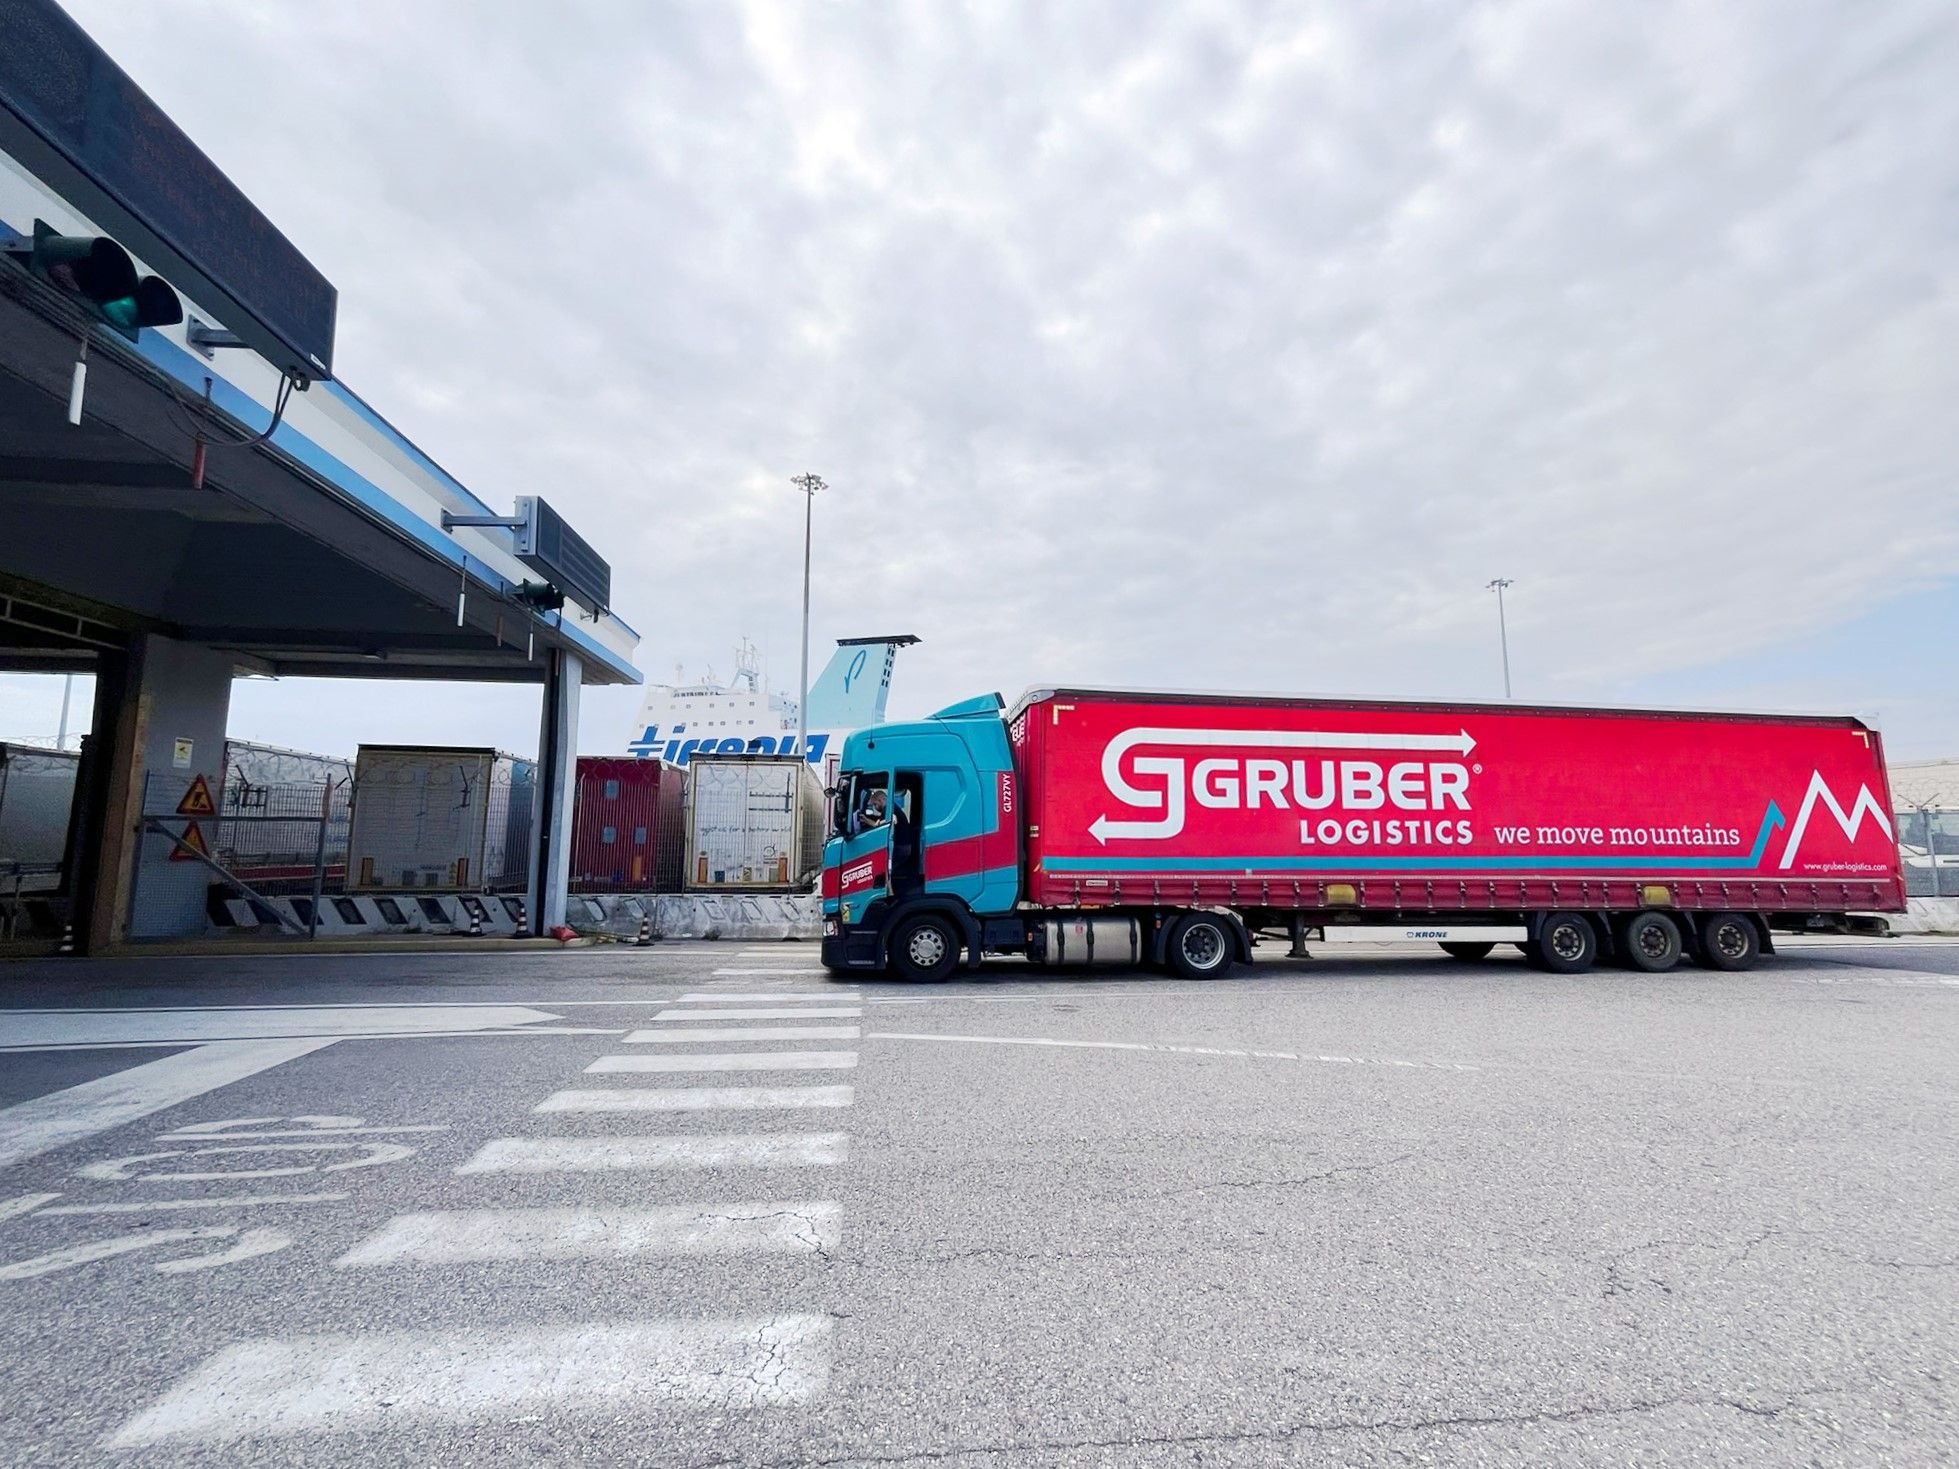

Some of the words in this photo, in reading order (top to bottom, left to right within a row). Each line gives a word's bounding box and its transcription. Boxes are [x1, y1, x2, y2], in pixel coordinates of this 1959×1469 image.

[1191, 758, 1472, 810] GRUBER
[1300, 819, 1473, 846] LOGISTICS
[1494, 826, 1531, 844] we
[1536, 826, 1604, 845] move
[1609, 822, 1741, 846] mountains
